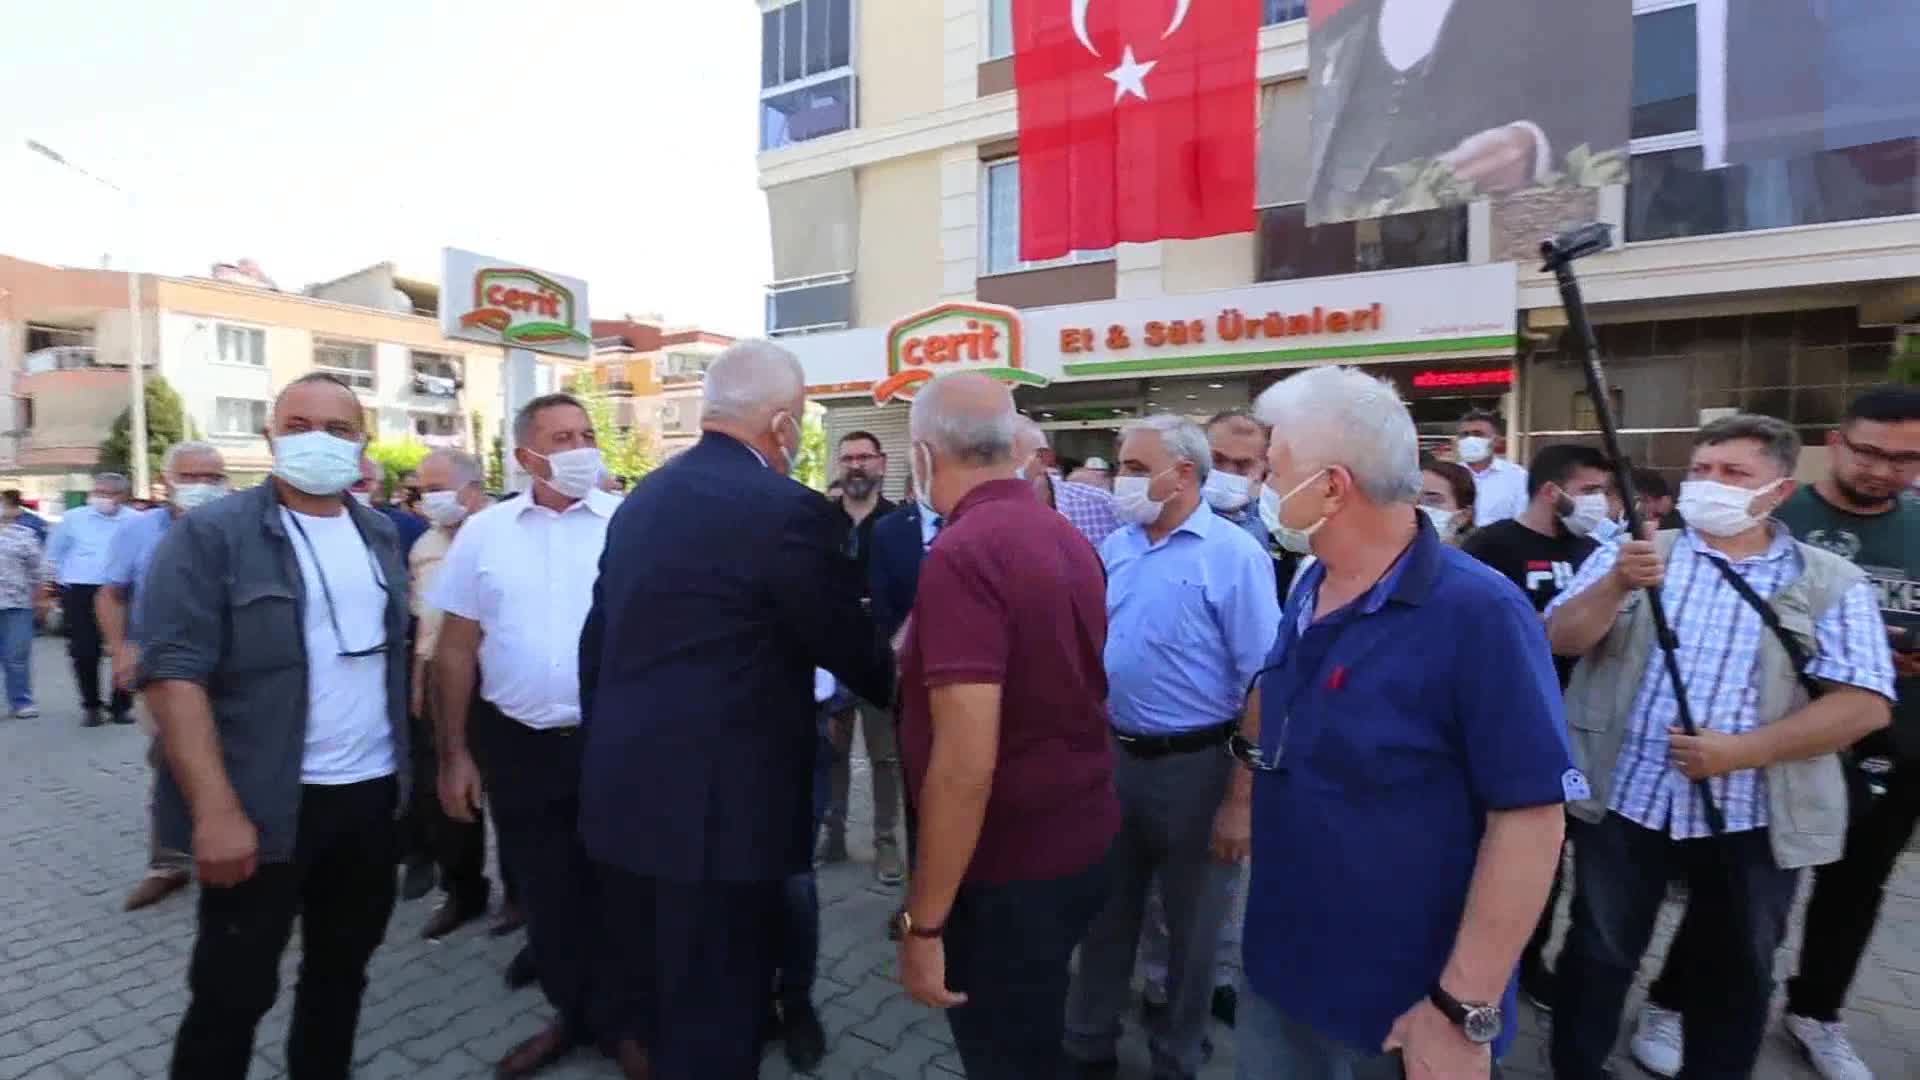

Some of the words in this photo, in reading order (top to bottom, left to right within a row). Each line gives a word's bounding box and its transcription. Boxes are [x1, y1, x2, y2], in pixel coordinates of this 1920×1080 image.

[487, 284, 561, 319] cerit
[902, 320, 999, 365] cerit
[1060, 328, 1094, 352] Et
[1105, 325, 1131, 350] &
[1144, 319, 1205, 347] Süt
[1217, 302, 1382, 341] Ürünleri
